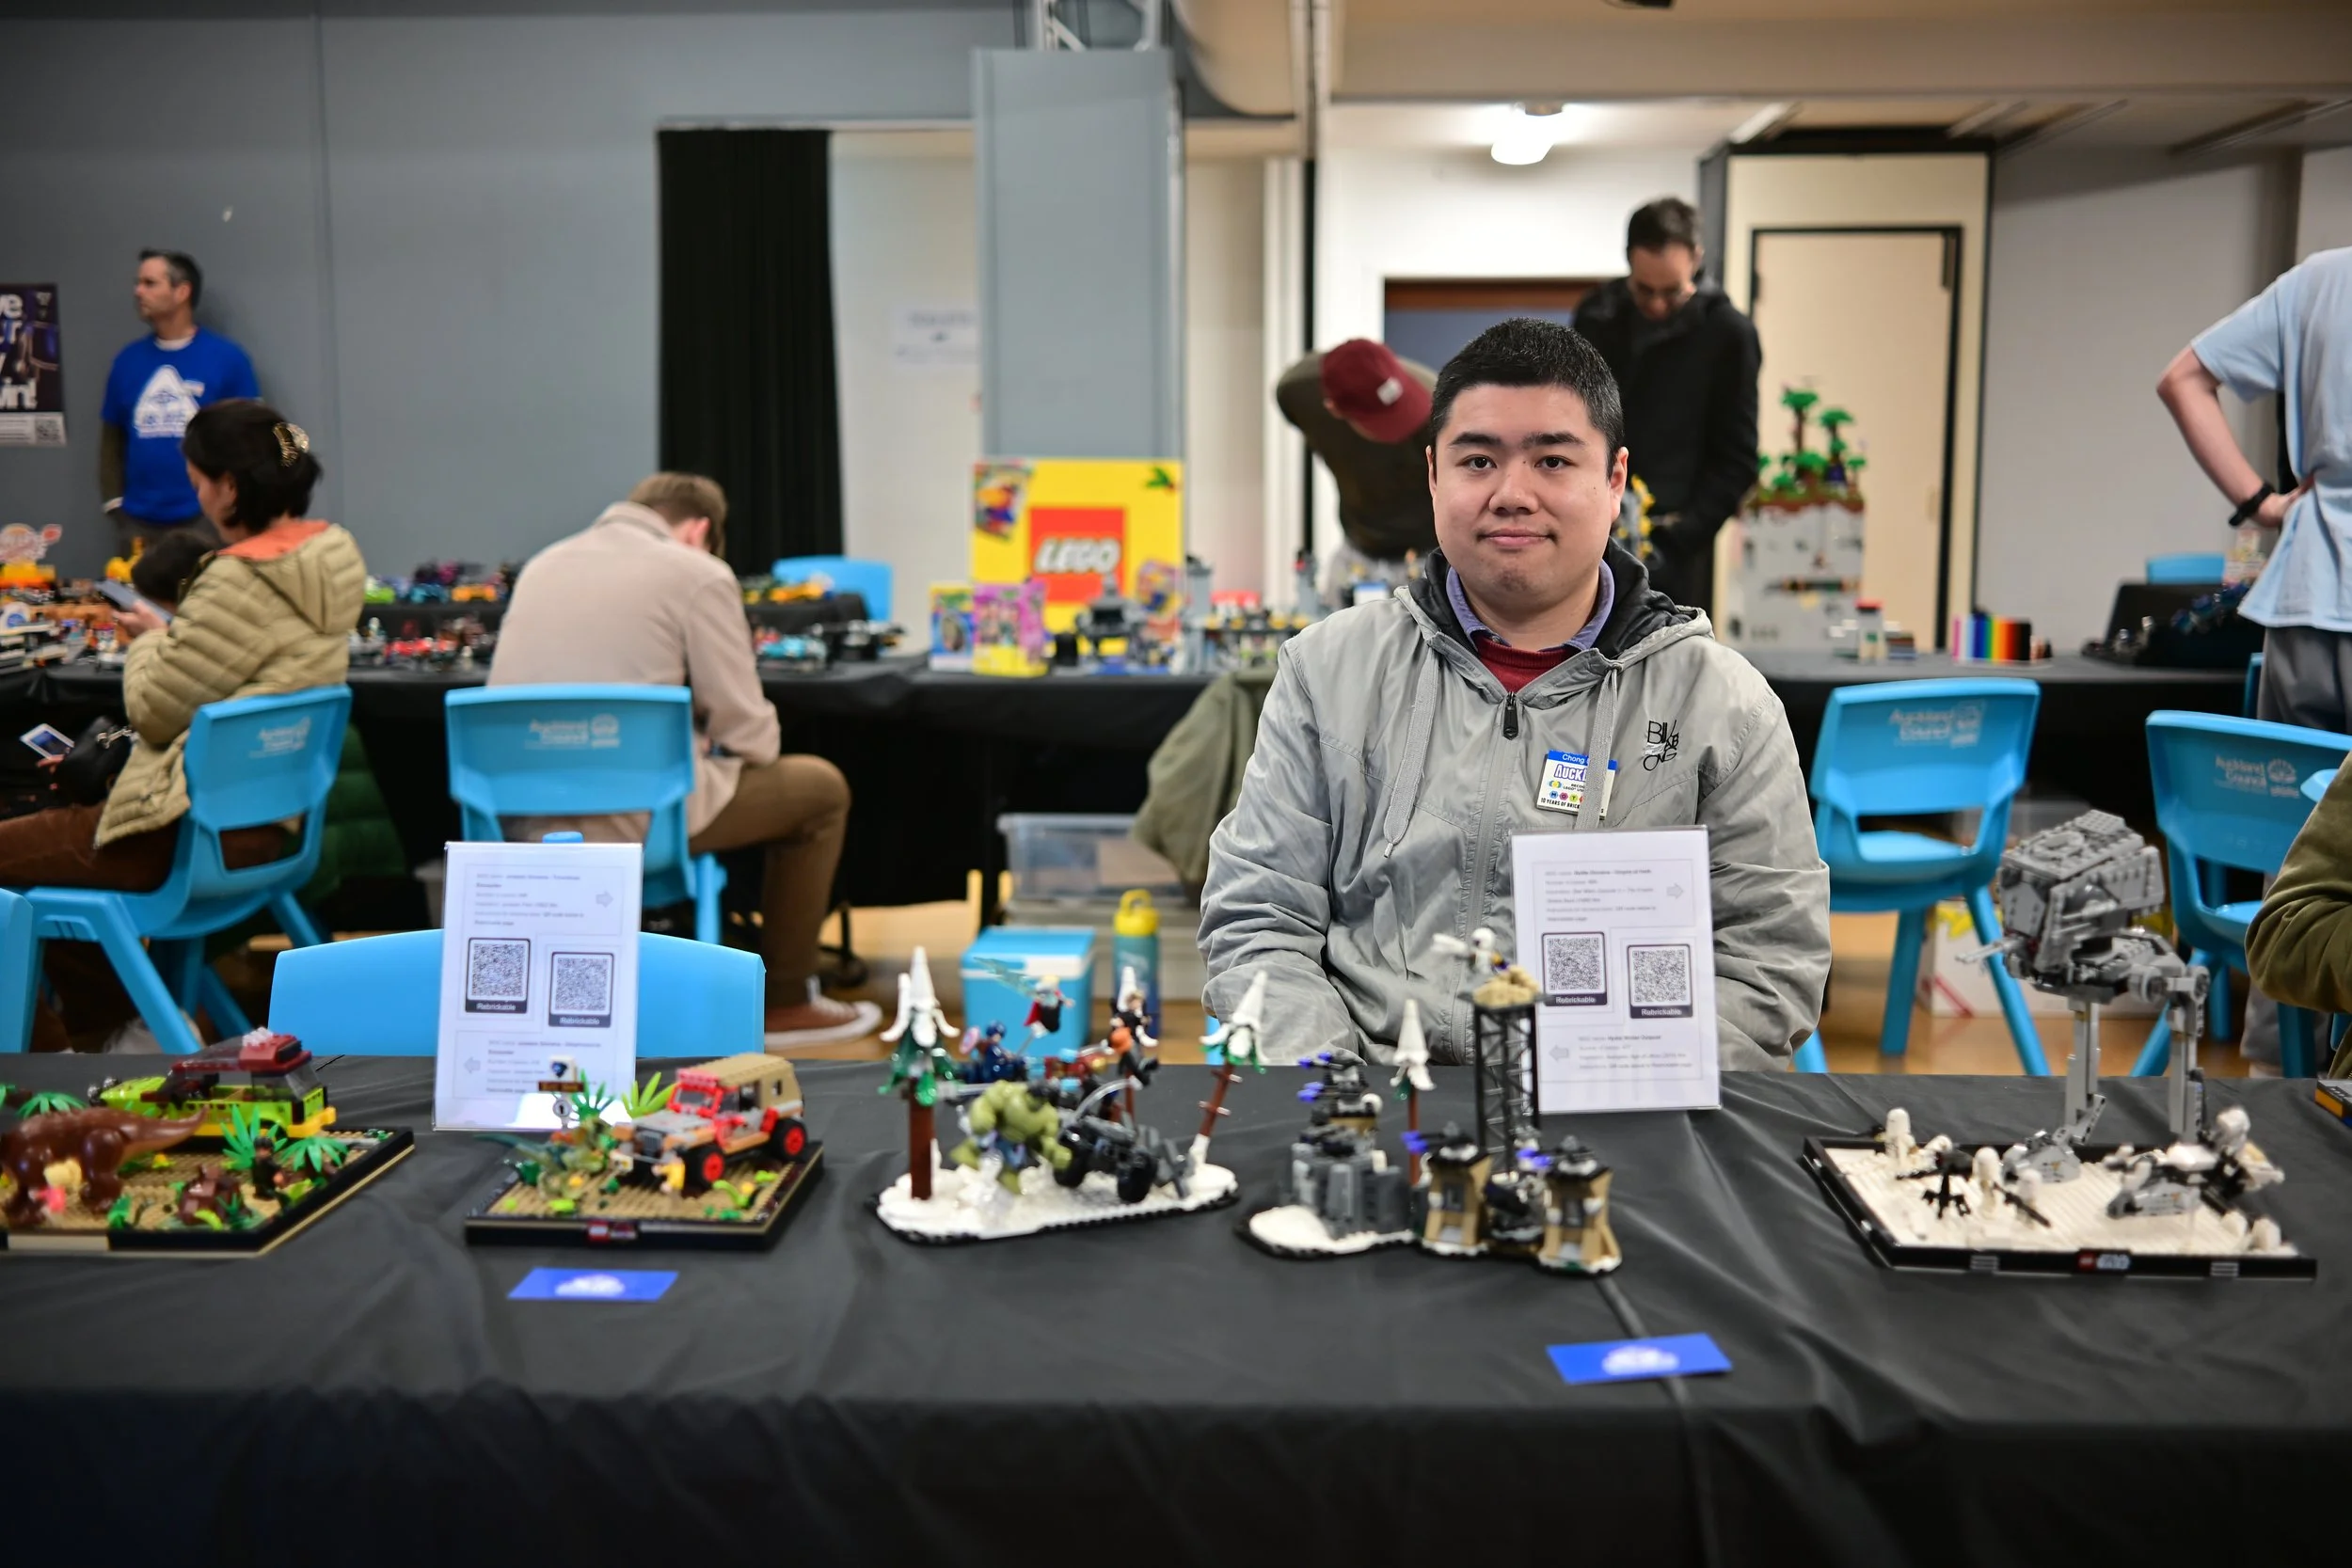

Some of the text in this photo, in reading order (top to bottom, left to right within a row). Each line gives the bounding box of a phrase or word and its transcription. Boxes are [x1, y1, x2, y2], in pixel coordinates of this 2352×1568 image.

[1034, 536, 1122, 574] LEGO
[1562, 753, 1585, 765] Chong
[1554, 764, 1586, 782] AUCKL
